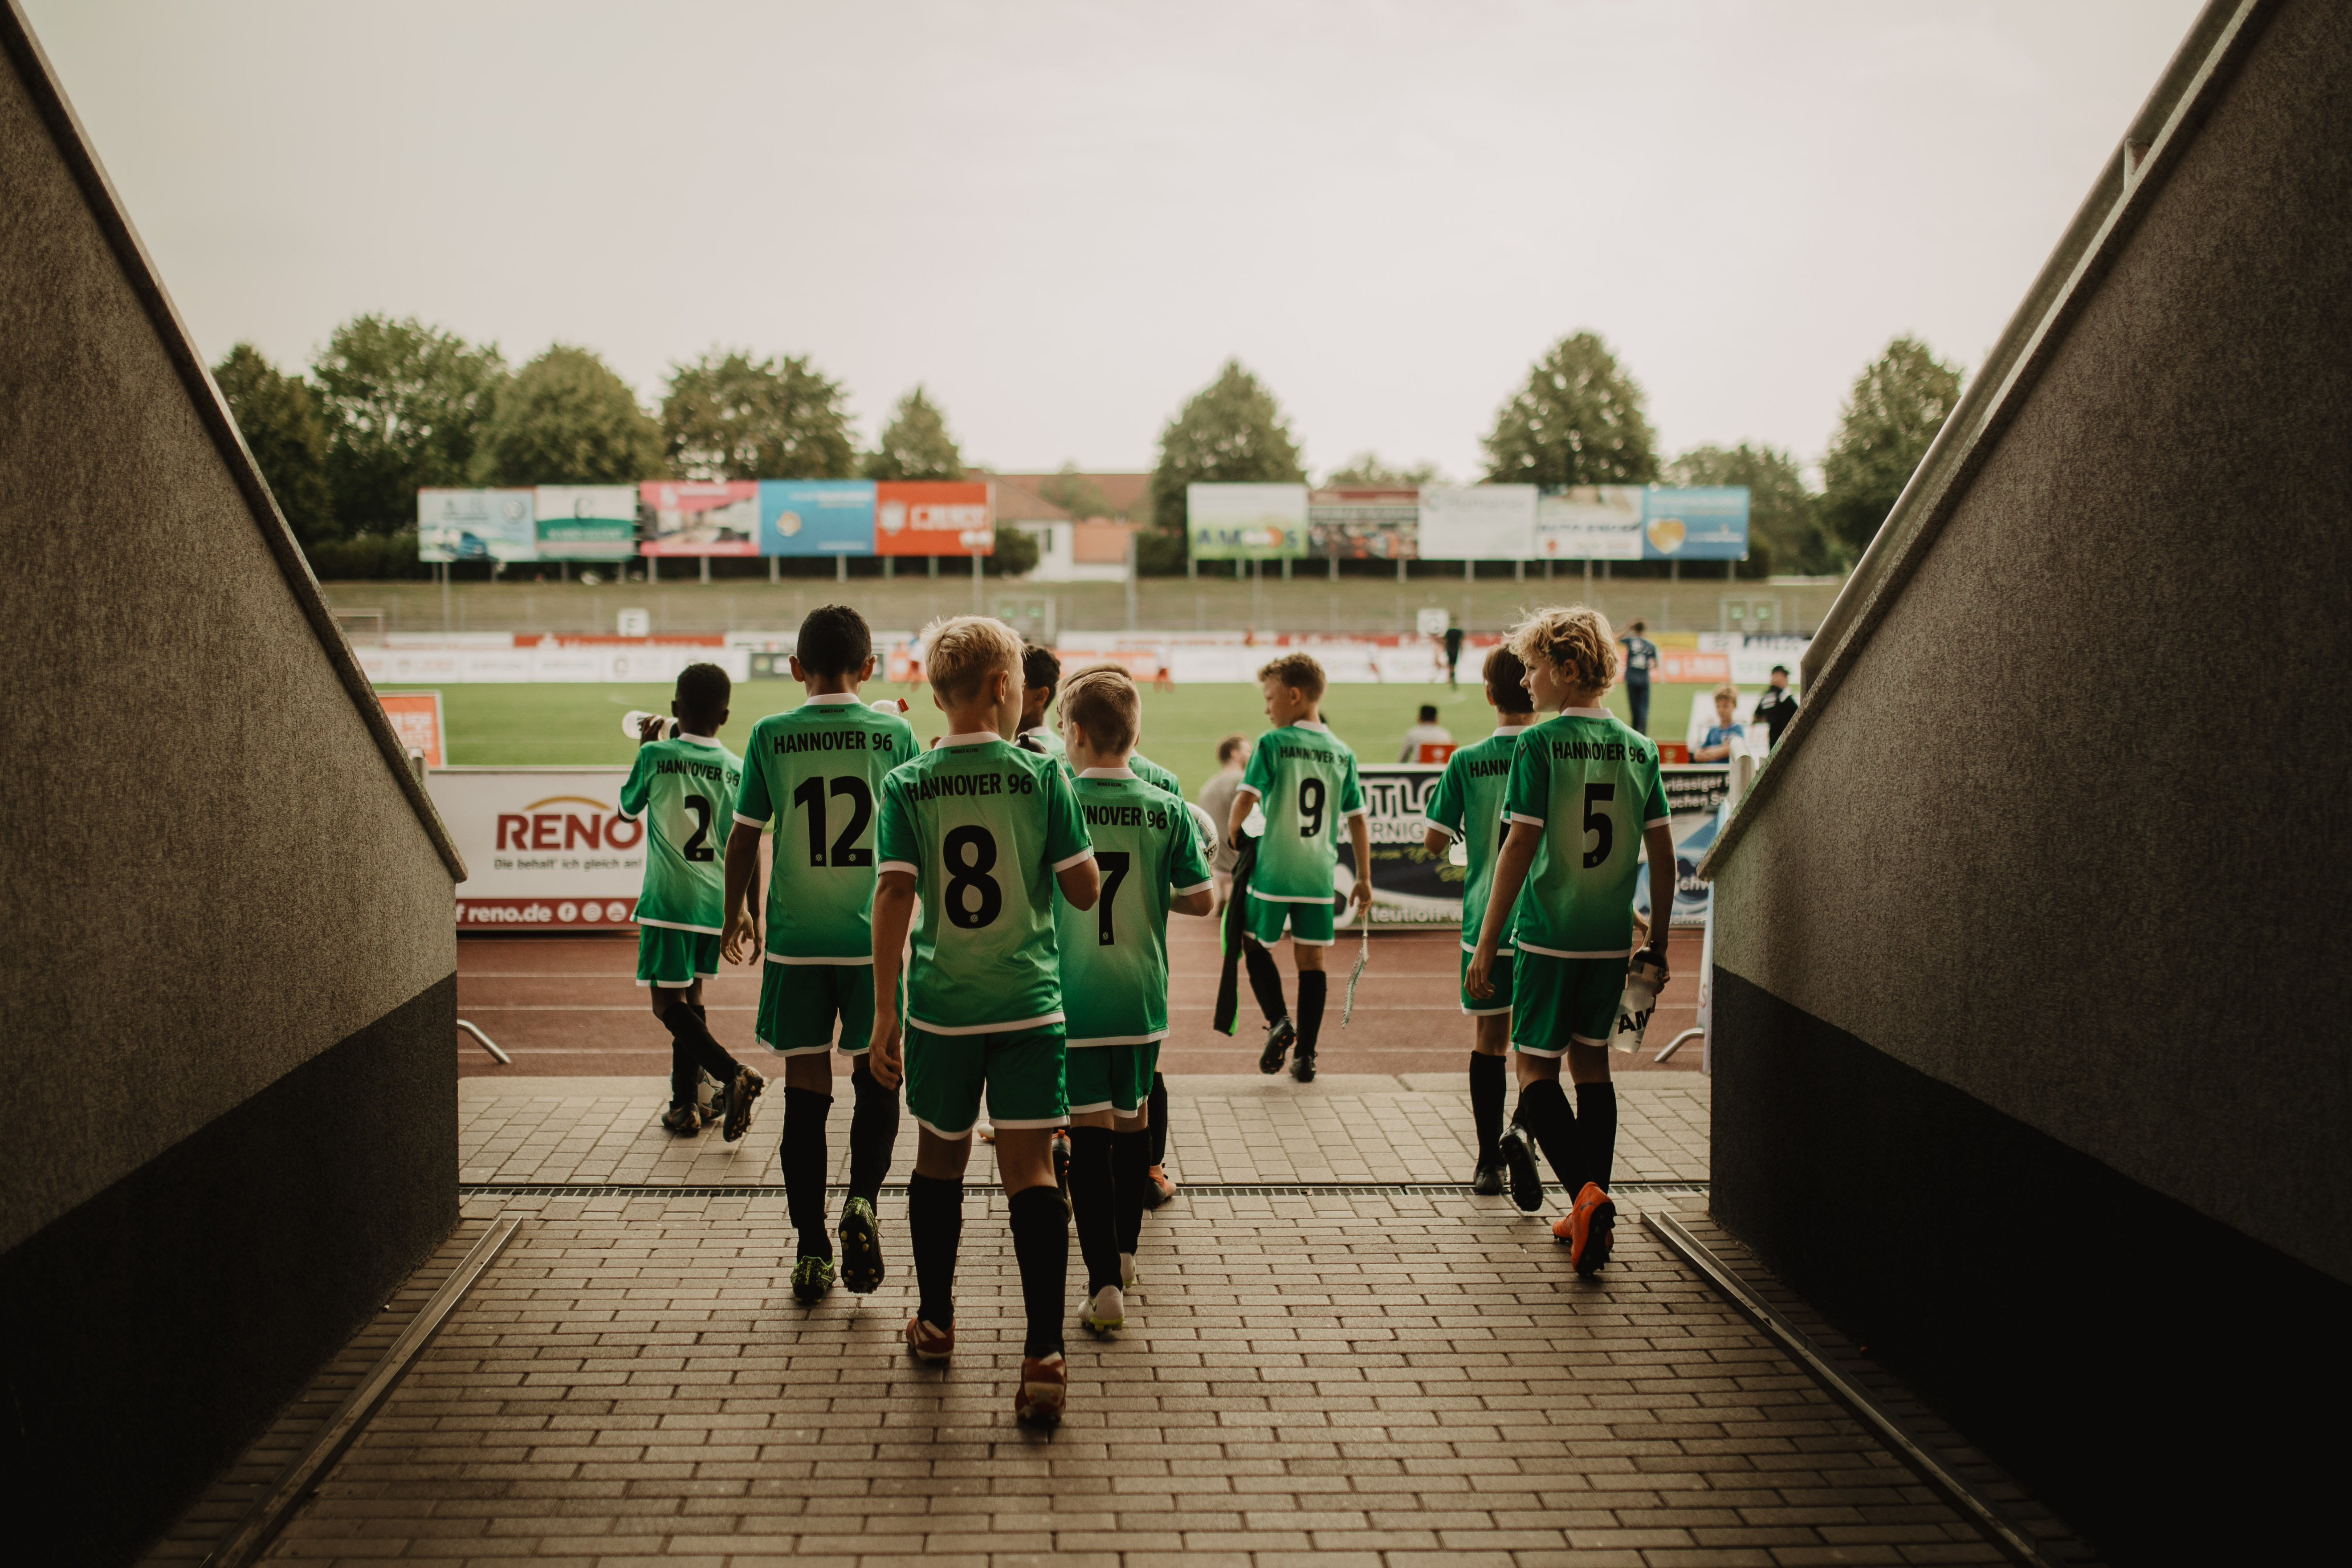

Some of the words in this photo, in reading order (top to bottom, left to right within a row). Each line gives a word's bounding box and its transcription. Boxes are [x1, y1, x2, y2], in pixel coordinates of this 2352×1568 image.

[774, 731, 866, 754] HANNOVER
[872, 732, 893, 752] 96
[1280, 746, 1334, 764] HANNOVER
[1552, 741, 1626, 762] HANNOVER
[1628, 746, 1646, 764] 96
[656, 760, 722, 782] HANNOVER
[726, 771, 741, 787] 96
[906, 773, 1001, 802] HANNOVER
[1007, 774, 1033, 795] 96
[794, 776, 872, 867] 12
[1147, 810, 1167, 830] 96
[1299, 778, 1325, 838] 9
[496, 814, 643, 851] RENO
[684, 794, 714, 862] 2
[1582, 783, 1615, 869] 5
[494, 859, 513, 870] Die
[562, 859, 579, 870] ich
[584, 859, 620, 872] gleich
[943, 825, 1002, 929] 8
[469, 902, 553, 923] reno.de
[1092, 851, 1130, 946] 7
